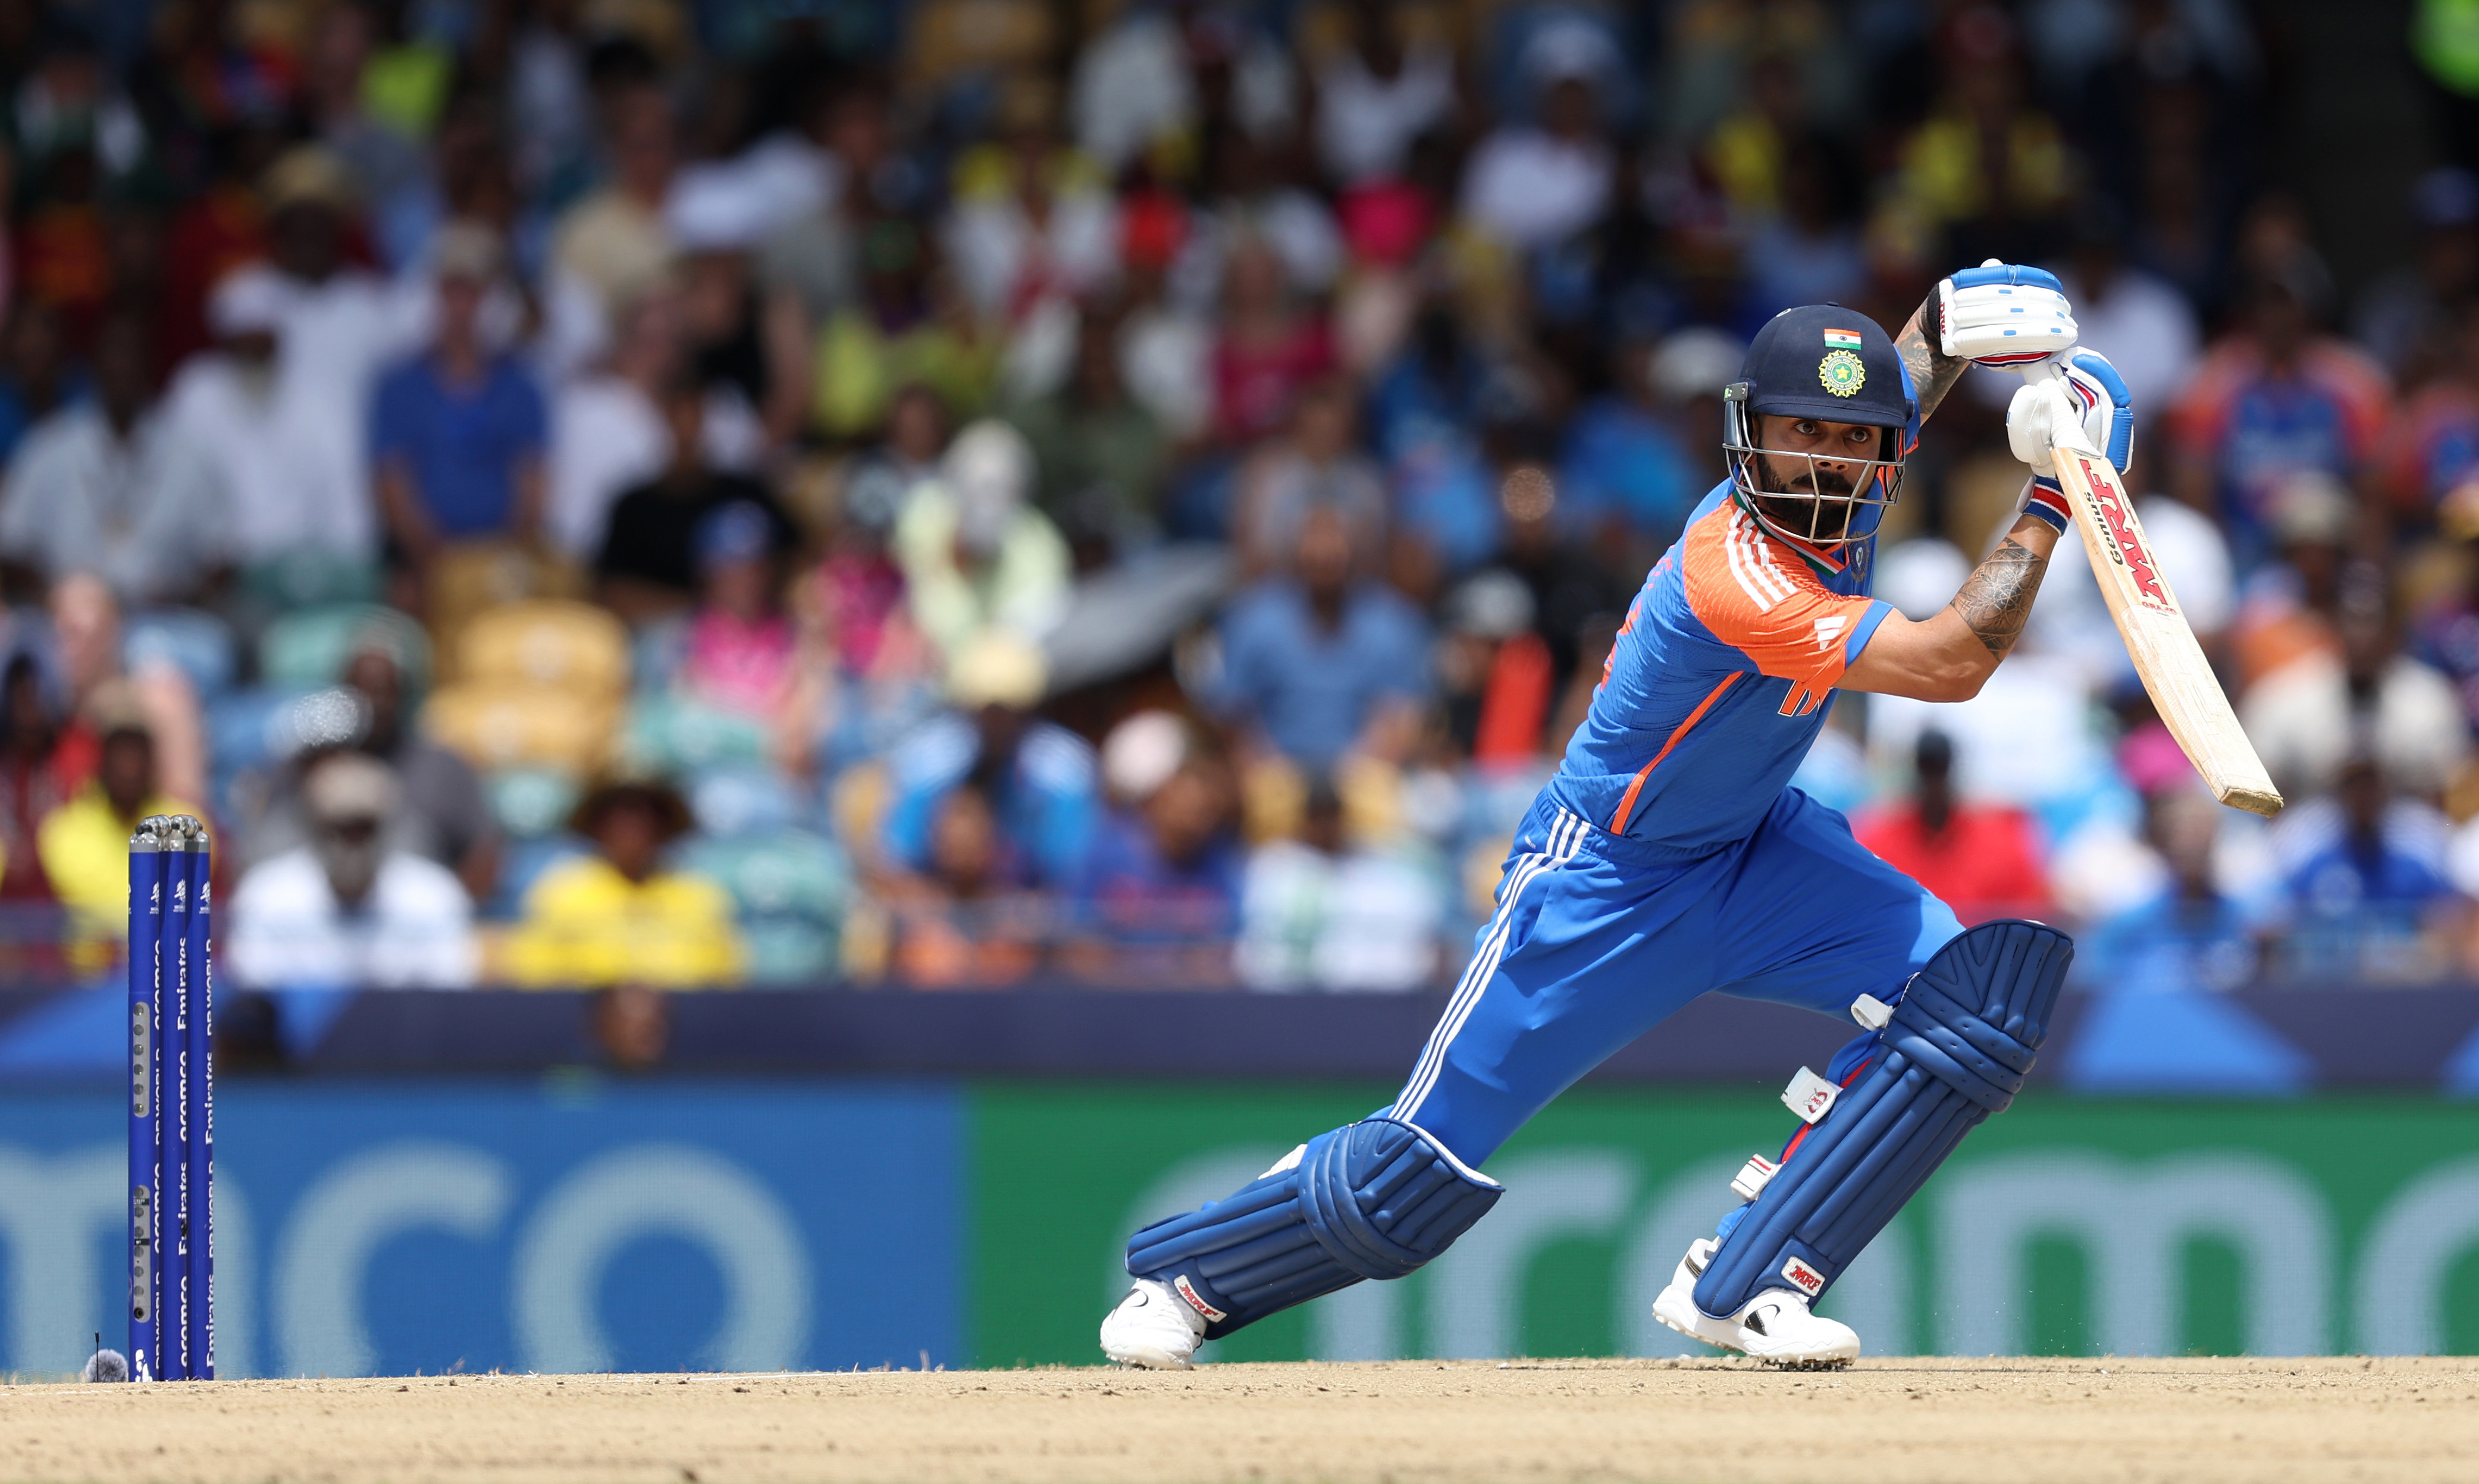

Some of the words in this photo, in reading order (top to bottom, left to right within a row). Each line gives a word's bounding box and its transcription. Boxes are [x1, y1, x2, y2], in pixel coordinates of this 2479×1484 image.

[2079, 459, 2168, 605] MRF
[2083, 491, 2123, 565] Genius
[178, 1162, 186, 1256] Eirates
[1179, 1284, 1218, 1316] MRF
[1789, 1265, 1821, 1290] MRF
